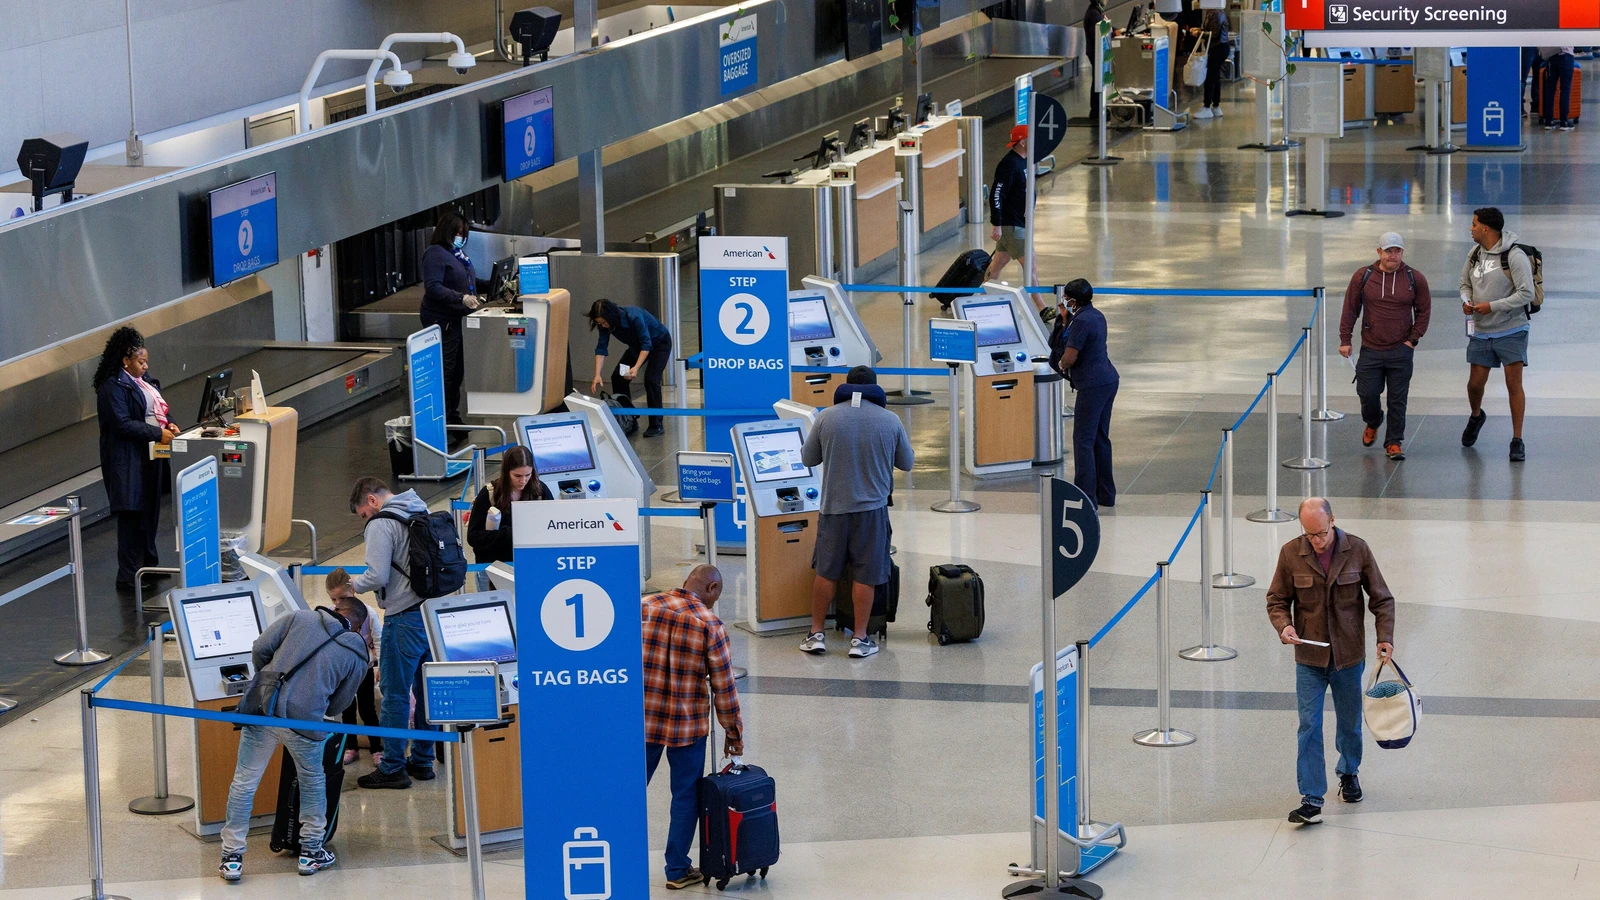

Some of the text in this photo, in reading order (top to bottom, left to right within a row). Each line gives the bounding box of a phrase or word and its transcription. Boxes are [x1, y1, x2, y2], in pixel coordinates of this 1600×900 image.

[1353, 6, 1507, 25] Security Screening
[723, 47, 751, 67] OVERSIZED
[724, 63, 748, 82] BAGGAGE
[1038, 104, 1059, 140] 4
[527, 132, 532, 151] 2
[240, 209, 249, 217] STEP
[242, 227, 249, 250] 2
[723, 249, 763, 258] American
[233, 255, 261, 273] DROP BAGS
[729, 276, 757, 287] STEP
[734, 302, 755, 335] 2
[708, 358, 784, 370] DROP BAGS
[682, 468, 698, 477] Bring
[682, 476, 722, 486] checked bags
[547, 519, 604, 530] American
[1058, 498, 1084, 559] 5
[556, 556, 597, 570] STEP
[565, 593, 585, 639] 1
[532, 668, 629, 686] TAG BAGS
